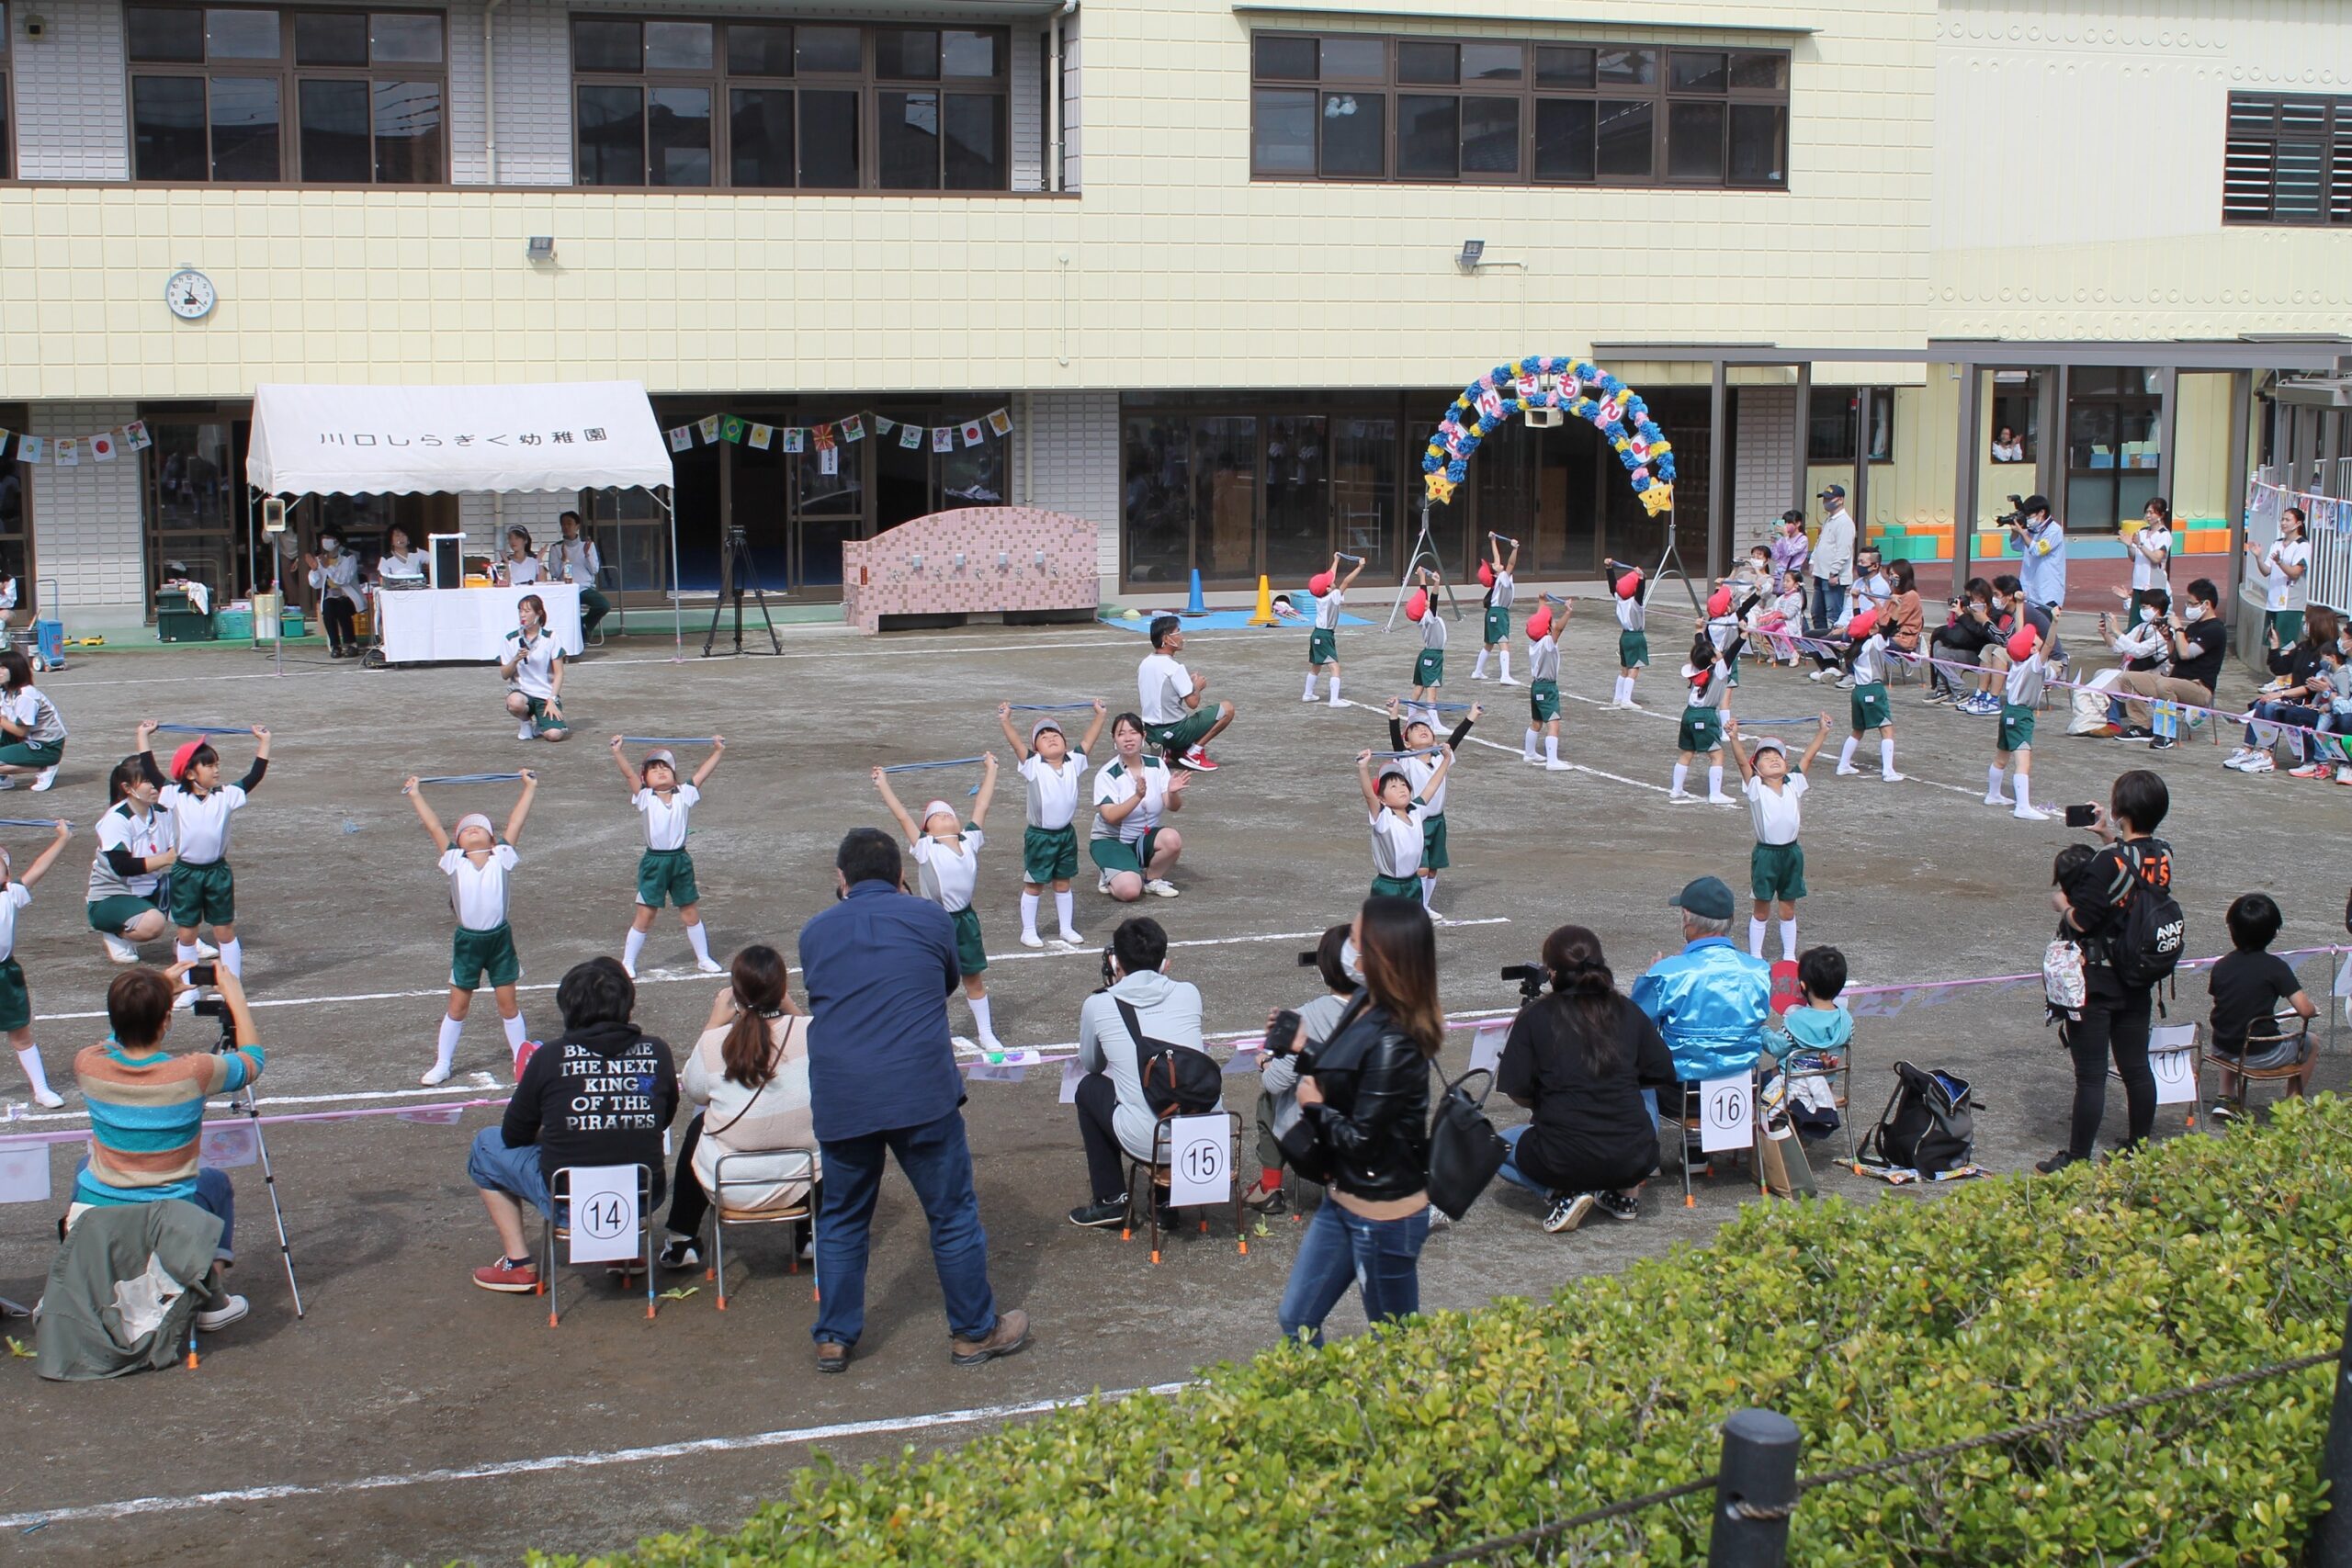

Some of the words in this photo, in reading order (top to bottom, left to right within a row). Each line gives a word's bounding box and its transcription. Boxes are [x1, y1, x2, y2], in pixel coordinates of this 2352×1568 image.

[321, 428, 607, 447] 川口しらぎく幼稚園
[2156, 919, 2184, 941] ANAP
[563, 1043, 653, 1058] BEME
[560, 1060, 601, 1077] THE
[607, 1059, 658, 1074] NEXT
[583, 1077, 639, 1092] KING
[571, 1096, 604, 1111] OF
[610, 1095, 650, 1111] THE
[1715, 1093, 1740, 1122] 16
[565, 1114, 656, 1130] PIRATES
[1188, 1146, 1216, 1177] 15
[590, 1200, 621, 1231] 14
